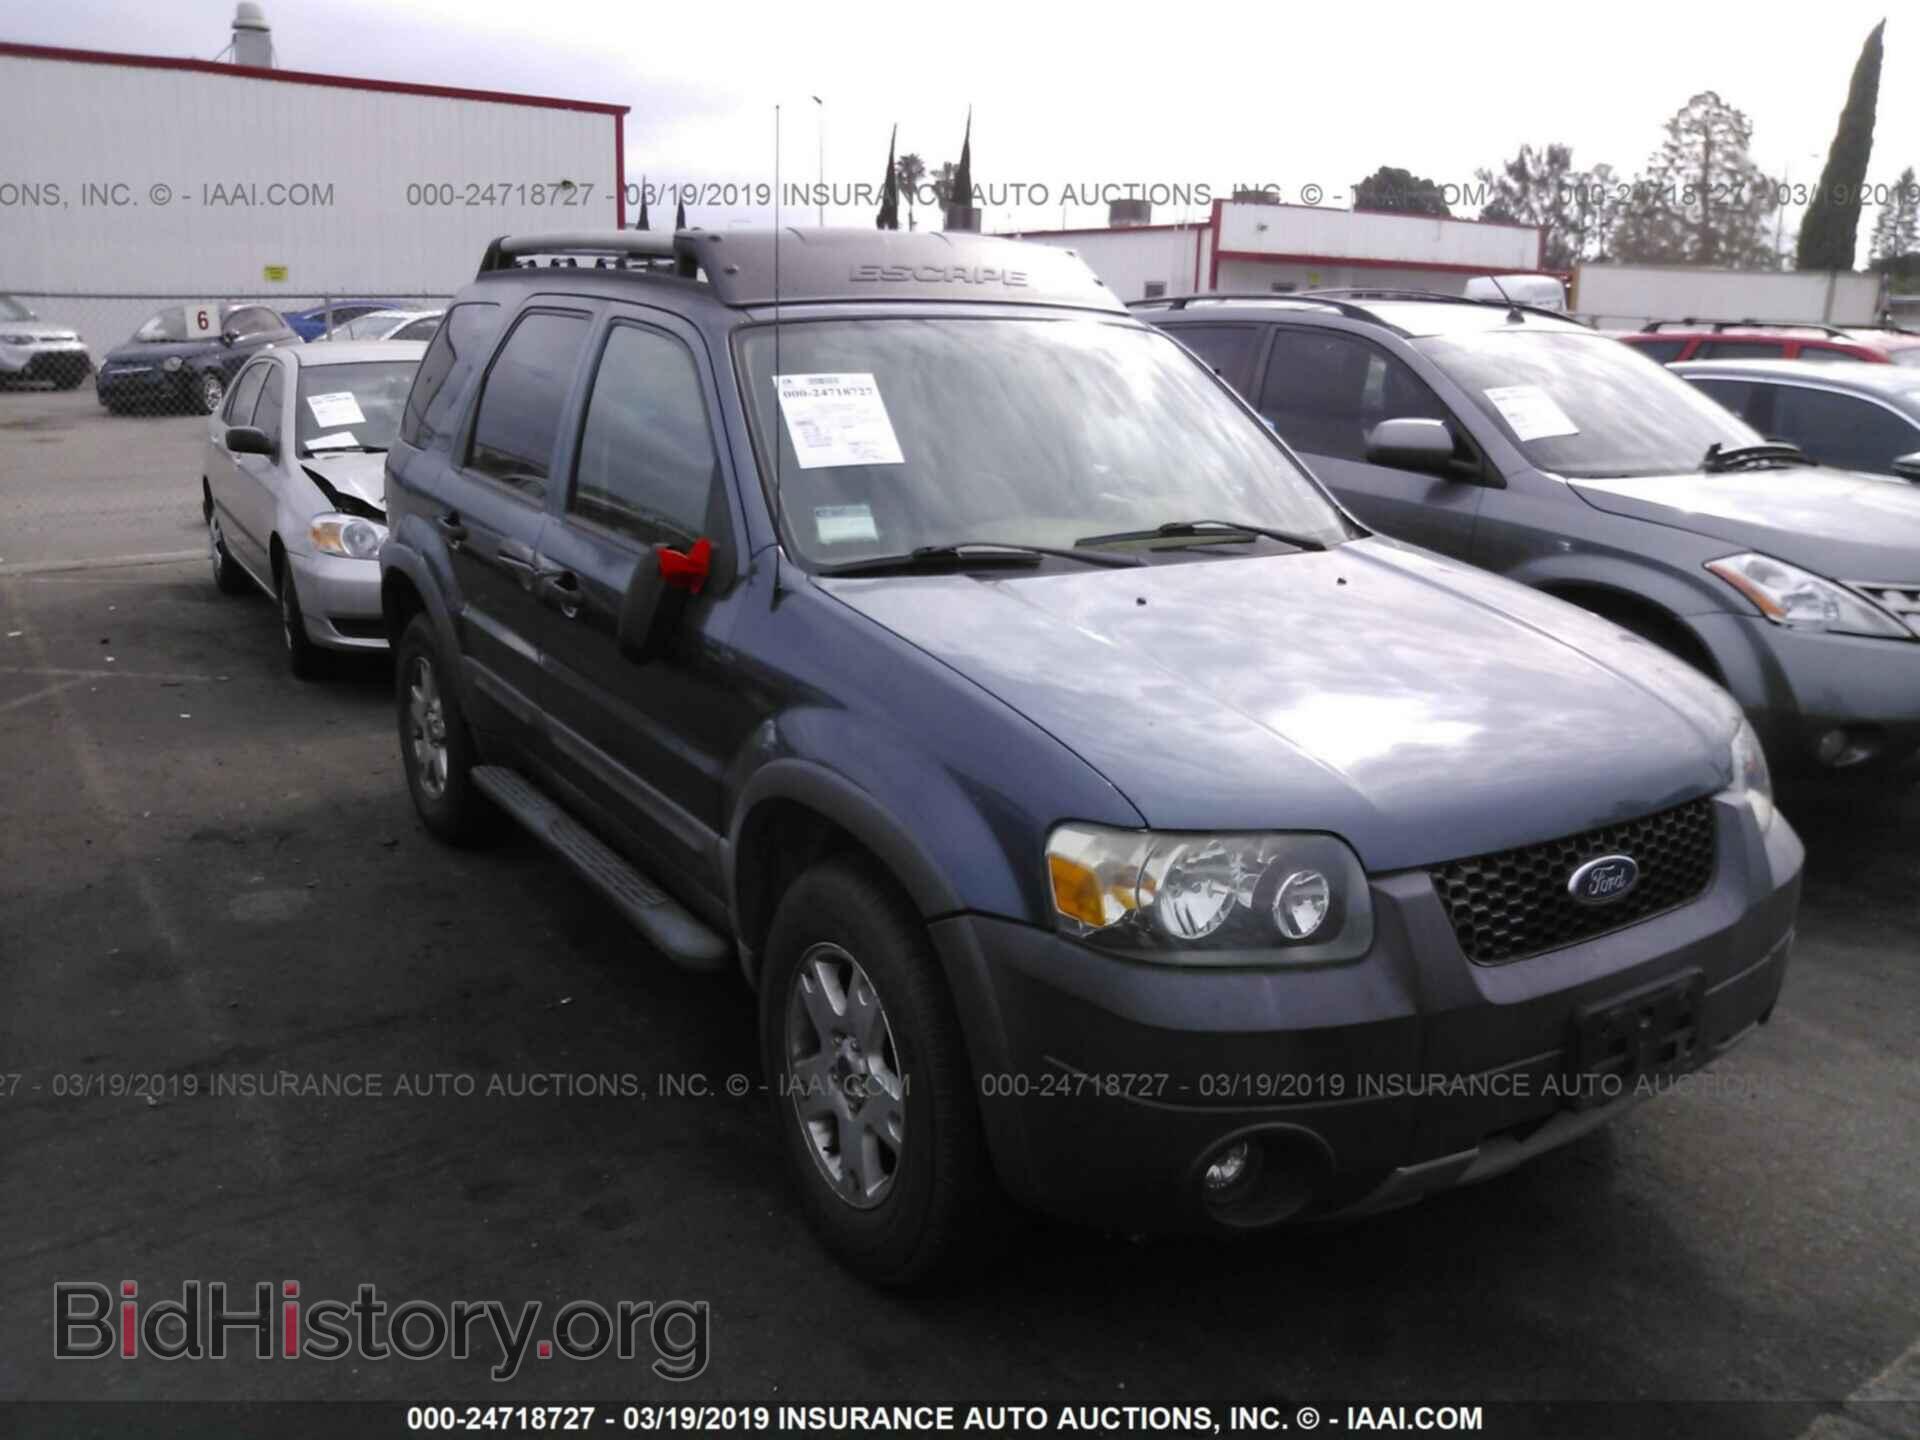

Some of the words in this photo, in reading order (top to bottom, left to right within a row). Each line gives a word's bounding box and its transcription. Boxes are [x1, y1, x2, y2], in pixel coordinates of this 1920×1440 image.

[849, 264, 1028, 288] ESCAPE
[196, 310, 209, 330] 6
[1588, 864, 1626, 895] Ford
